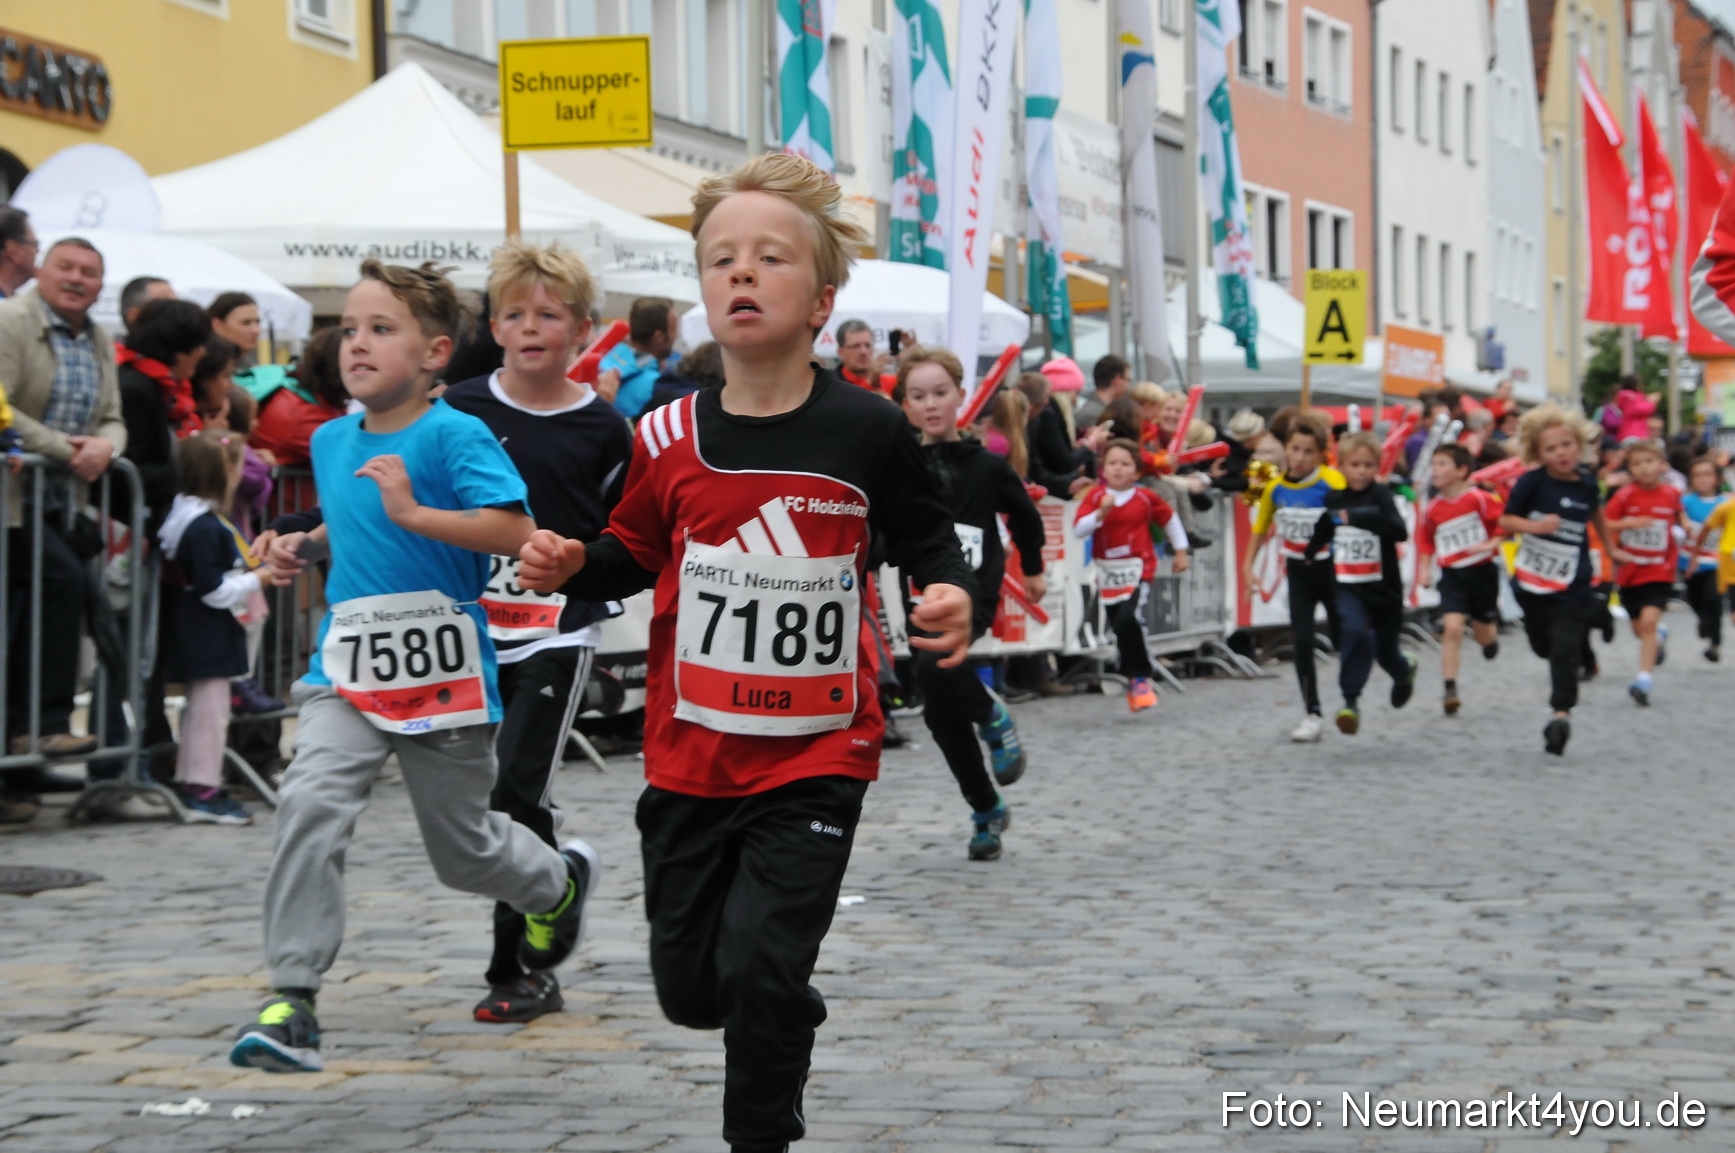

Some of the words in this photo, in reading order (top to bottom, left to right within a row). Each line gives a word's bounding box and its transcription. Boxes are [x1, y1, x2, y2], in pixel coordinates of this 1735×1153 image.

[511, 71, 640, 95] Schnupper-
[556, 98, 597, 120] lauf
[964, 126, 984, 269] Audi
[1310, 273, 1360, 290] Block
[1316, 299, 1350, 343] A
[784, 496, 805, 512] FC
[1524, 548, 1570, 577] 7574
[684, 562, 738, 586] PARTL
[745, 572, 834, 593] Neumarkt
[334, 613, 370, 626] PARTL
[373, 606, 445, 623] Neumarkt
[698, 591, 844, 667] 7189
[339, 624, 465, 683] 7580
[732, 682, 792, 709] Luca
[823, 825, 843, 837] JAKO
